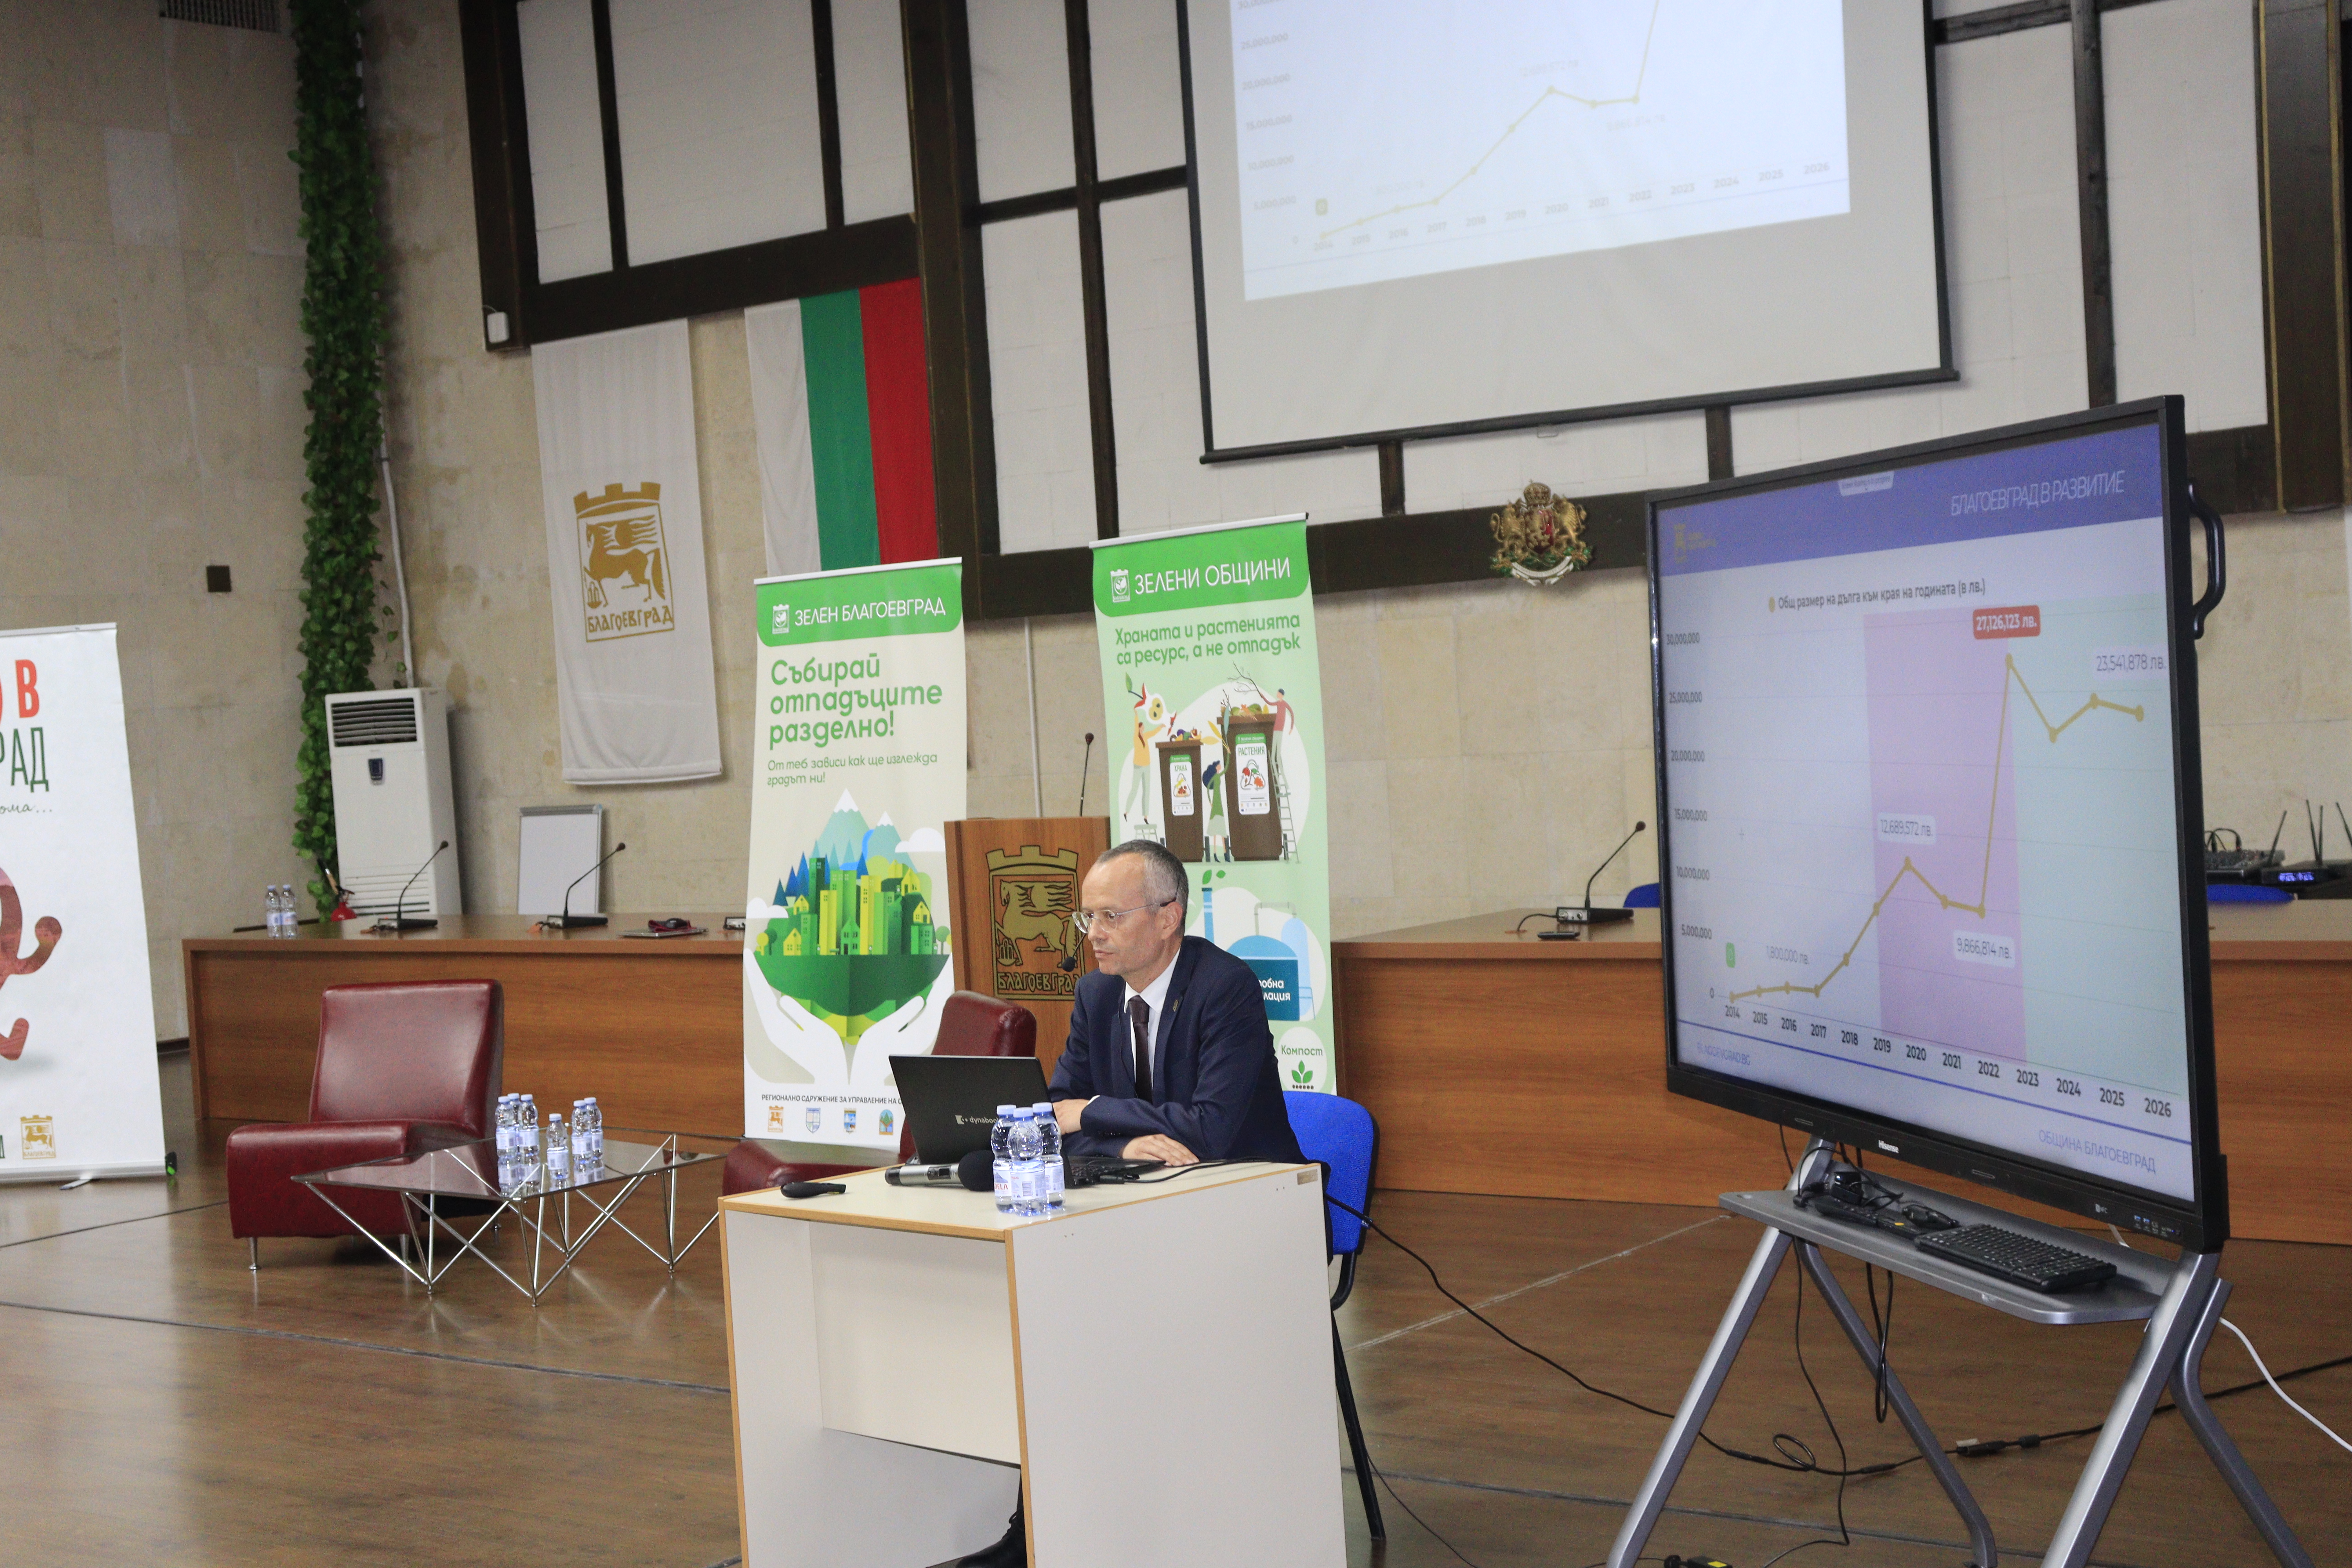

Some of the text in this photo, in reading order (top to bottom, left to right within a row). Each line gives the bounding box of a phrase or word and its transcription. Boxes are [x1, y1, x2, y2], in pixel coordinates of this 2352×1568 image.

[1314, 162, 1830, 252] 2014 2015 2016 2017 2018 2019 2020 2021 2022 2023 2024 2025 2026
[1951, 470, 2125, 516] БЛАГОЕВГРАД В РАЗВИТИЕ
[1135, 557, 1290, 595] ЗЕЛЕНИ ОБЩИНИ
[1778, 595, 1795, 609] Общ
[1797, 595, 1823, 610] размер
[1826, 595, 1835, 605] на
[1838, 592, 1860, 606] дълга
[1863, 590, 1878, 603] към
[1881, 589, 1900, 604] края
[1902, 587, 1913, 599] на
[1915, 583, 1956, 599] годината
[588, 605, 673, 633] БЛАГОЕВГРАД
[795, 597, 946, 626] ЗЕЛЕН БЛАГОЕВГРАД
[1976, 614, 2037, 632] 27,126,123 лв.
[1116, 614, 1300, 648] Храната и растенията
[1117, 632, 1301, 667] са ресурс, а не отпадък
[771, 653, 880, 687] Събирай
[2096, 654, 2166, 673] 23,541,878 лв.
[770, 684, 942, 716] отпадъците
[769, 710, 895, 750] разделно!
[768, 752, 937, 771] От теб зависи как ще изглежда
[1238, 746, 1265, 755] РАСТЕНИЯ
[767, 772, 826, 788] градът ни!
[1880, 819, 1919, 836] 12,689,572
[1957, 938, 1996, 956] 9,866,814
[1710, 987, 1714, 998] 0
[1281, 1044, 1323, 1056] Компост
[1725, 1005, 2172, 1117] 2014 2015 2016 2017 2018 2019 2020 2021 2022 2023 2024 2025 2026
[969, 1116, 998, 1124] dynaboo
[1878, 1140, 1899, 1154] Hisense
[2038, 1130, 2156, 1173] ОБЩИНА БЛАГОЕВГРАД
